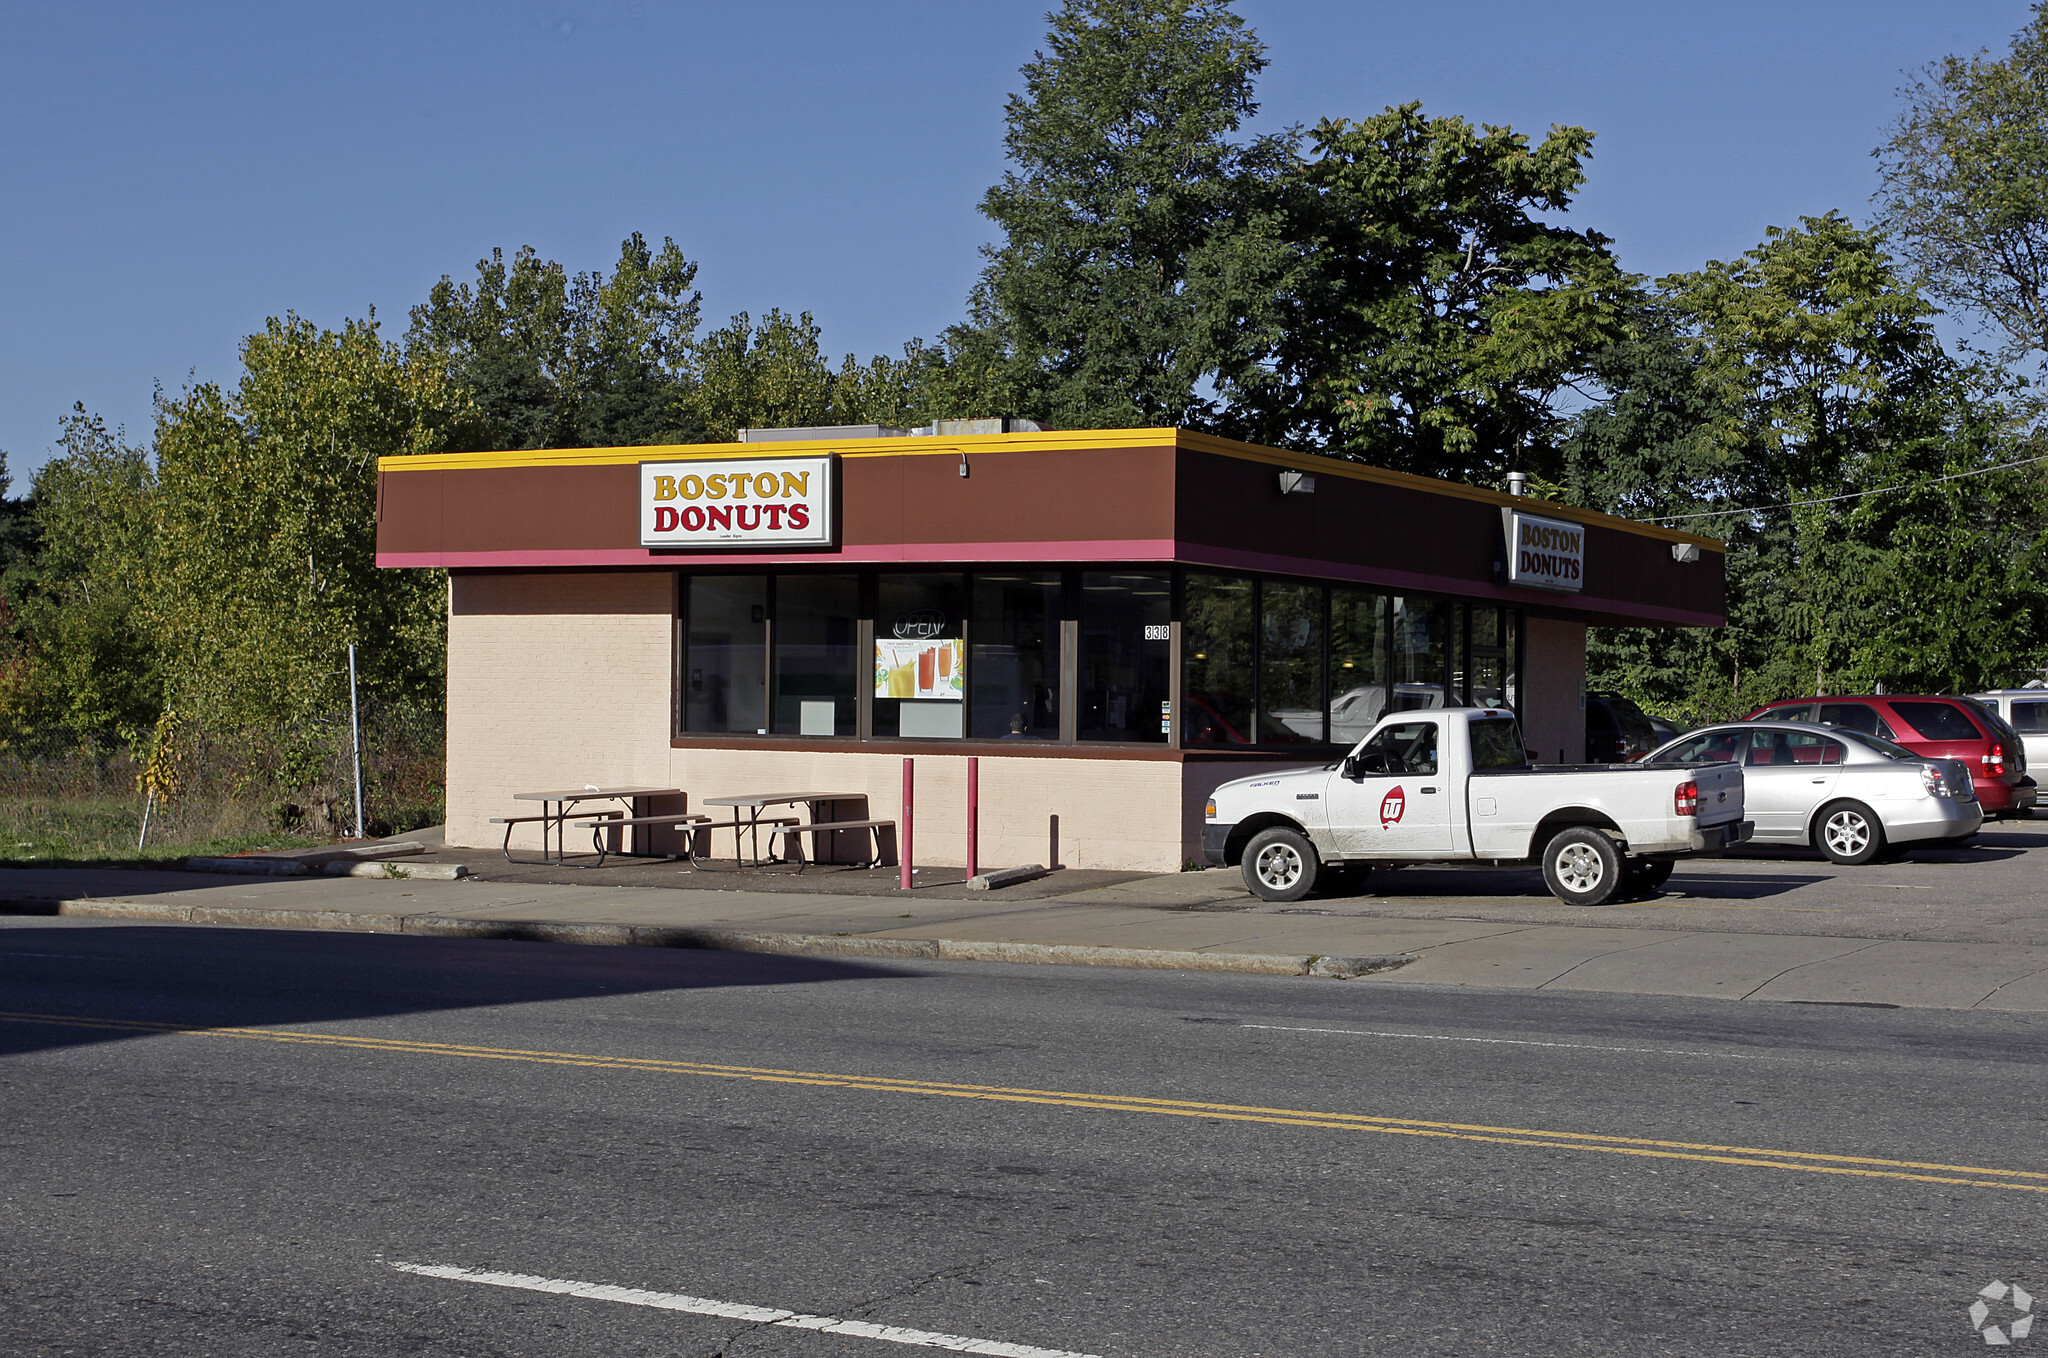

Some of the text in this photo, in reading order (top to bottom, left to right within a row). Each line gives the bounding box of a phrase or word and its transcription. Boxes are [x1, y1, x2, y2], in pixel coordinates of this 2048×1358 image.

[653, 471, 811, 501] BOSTON
[653, 504, 810, 532] DONUTS
[1521, 524, 1581, 554] BOSTON
[1520, 551, 1579, 580] DONUTS
[895, 615, 941, 635] OPEN
[1146, 626, 1169, 639] 338
[1249, 780, 1281, 788] FALKEN
